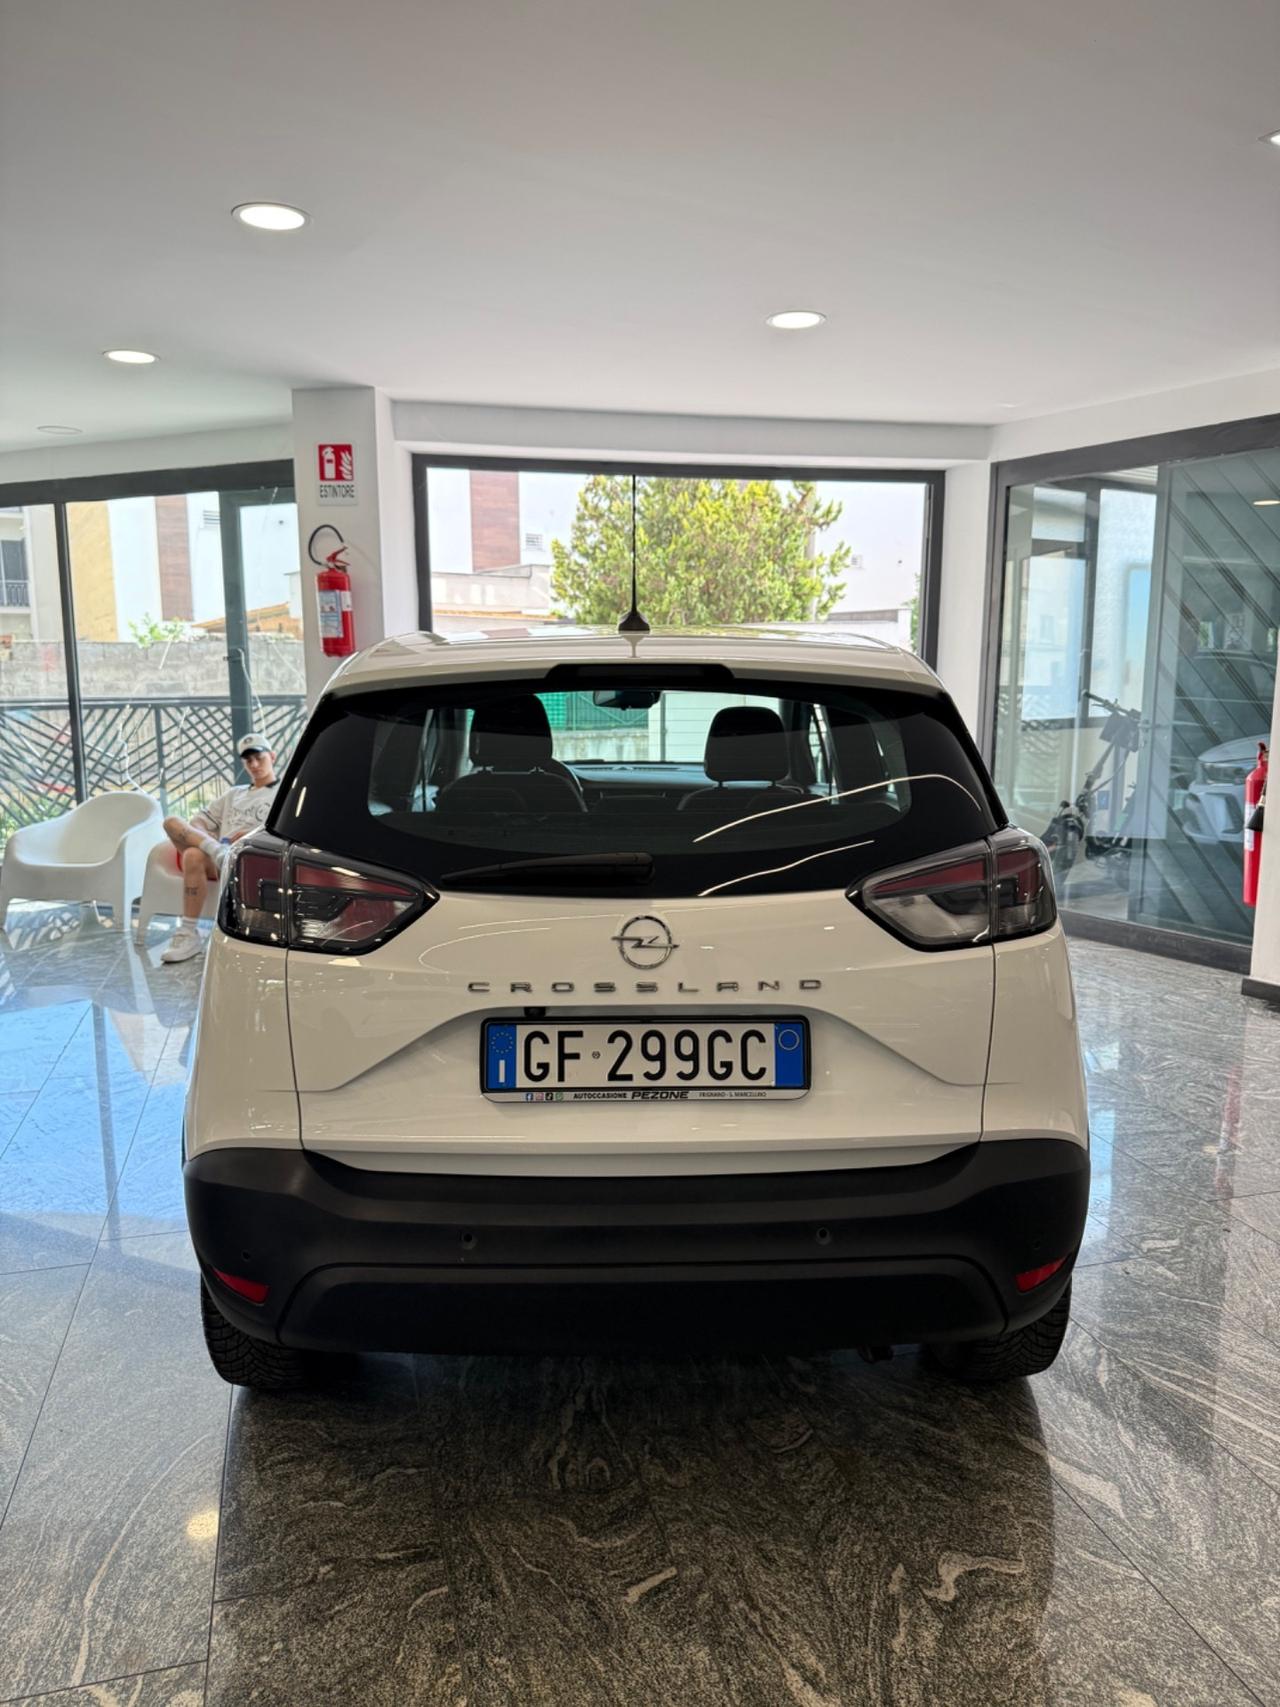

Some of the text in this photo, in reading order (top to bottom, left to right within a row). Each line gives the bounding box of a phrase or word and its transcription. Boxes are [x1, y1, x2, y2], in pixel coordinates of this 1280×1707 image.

[319, 484, 355, 498] ESTINTORE
[467, 980, 823, 994] CROSSLAND
[523, 1029, 767, 1083] GF 299GC
[573, 1091, 689, 1100] AUTOCCASIONE PEZONE
